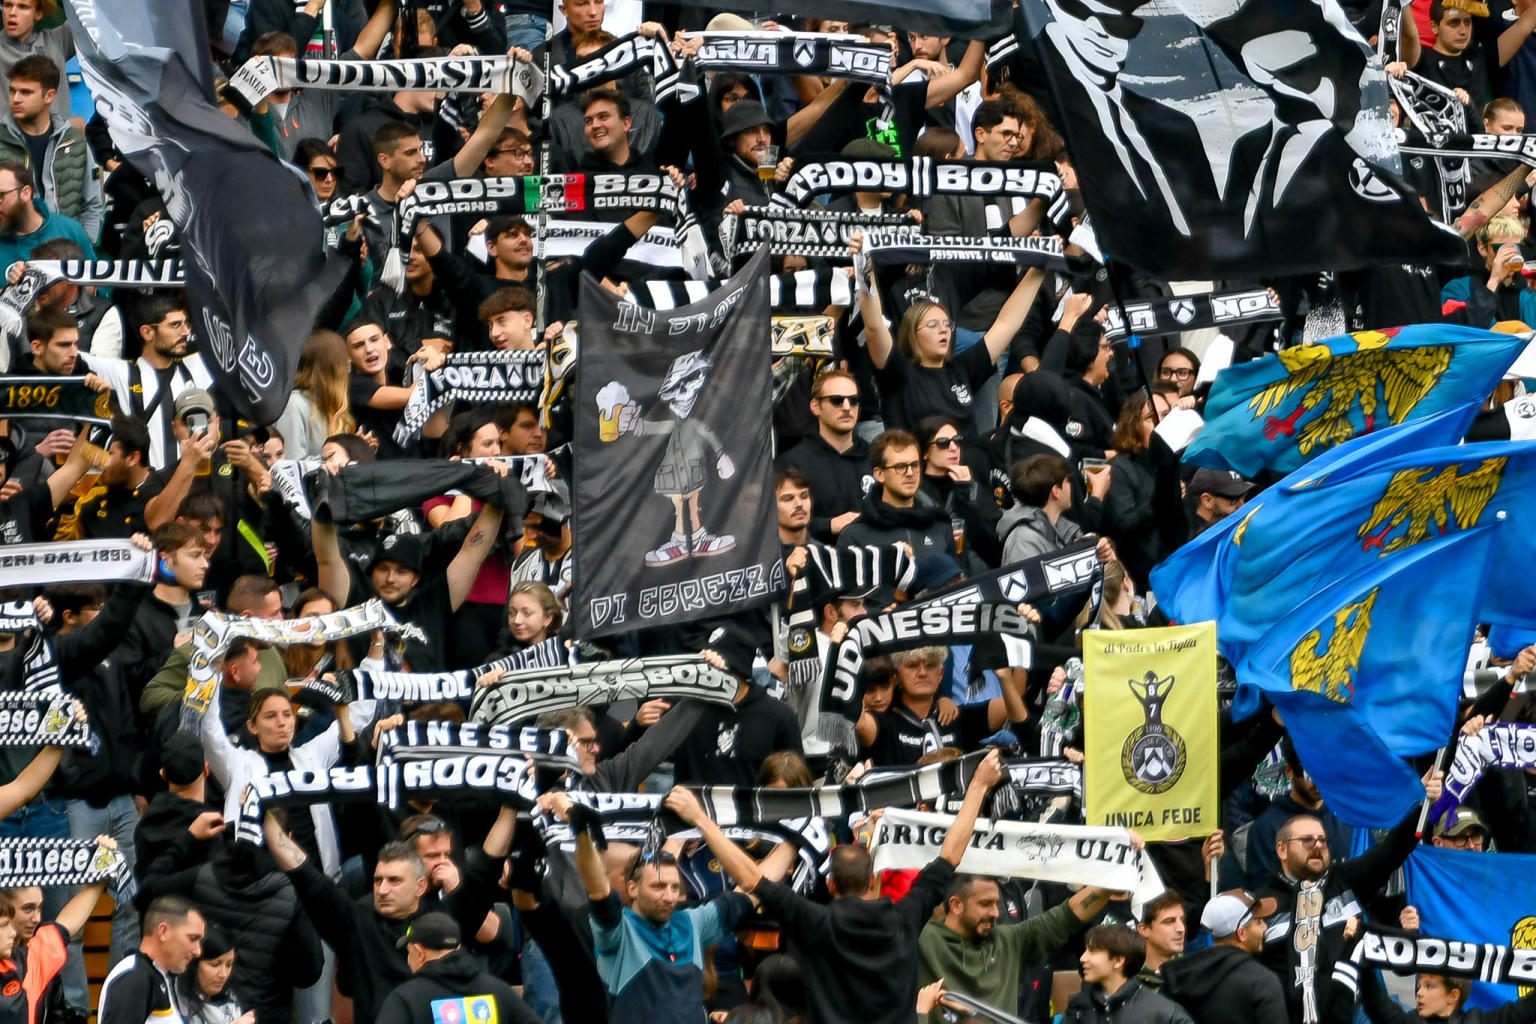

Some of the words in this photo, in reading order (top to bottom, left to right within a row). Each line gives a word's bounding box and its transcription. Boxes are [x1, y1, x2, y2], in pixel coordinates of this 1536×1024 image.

[700, 39, 778, 67] URVA
[302, 58, 497, 91] UDINESE
[744, 217, 820, 243] FORZA
[432, 367, 500, 392] FORZA
[5, 384, 60, 409] 1896
[50, 550, 84, 566] DAL
[90, 547, 132, 564] 1896
[590, 592, 627, 629] DI
[638, 557, 786, 619] EBREZZA
[1119, 641, 1152, 653] Padre
[1162, 806, 1201, 826] FEDE
[880, 822, 1005, 850] BRIGTA
